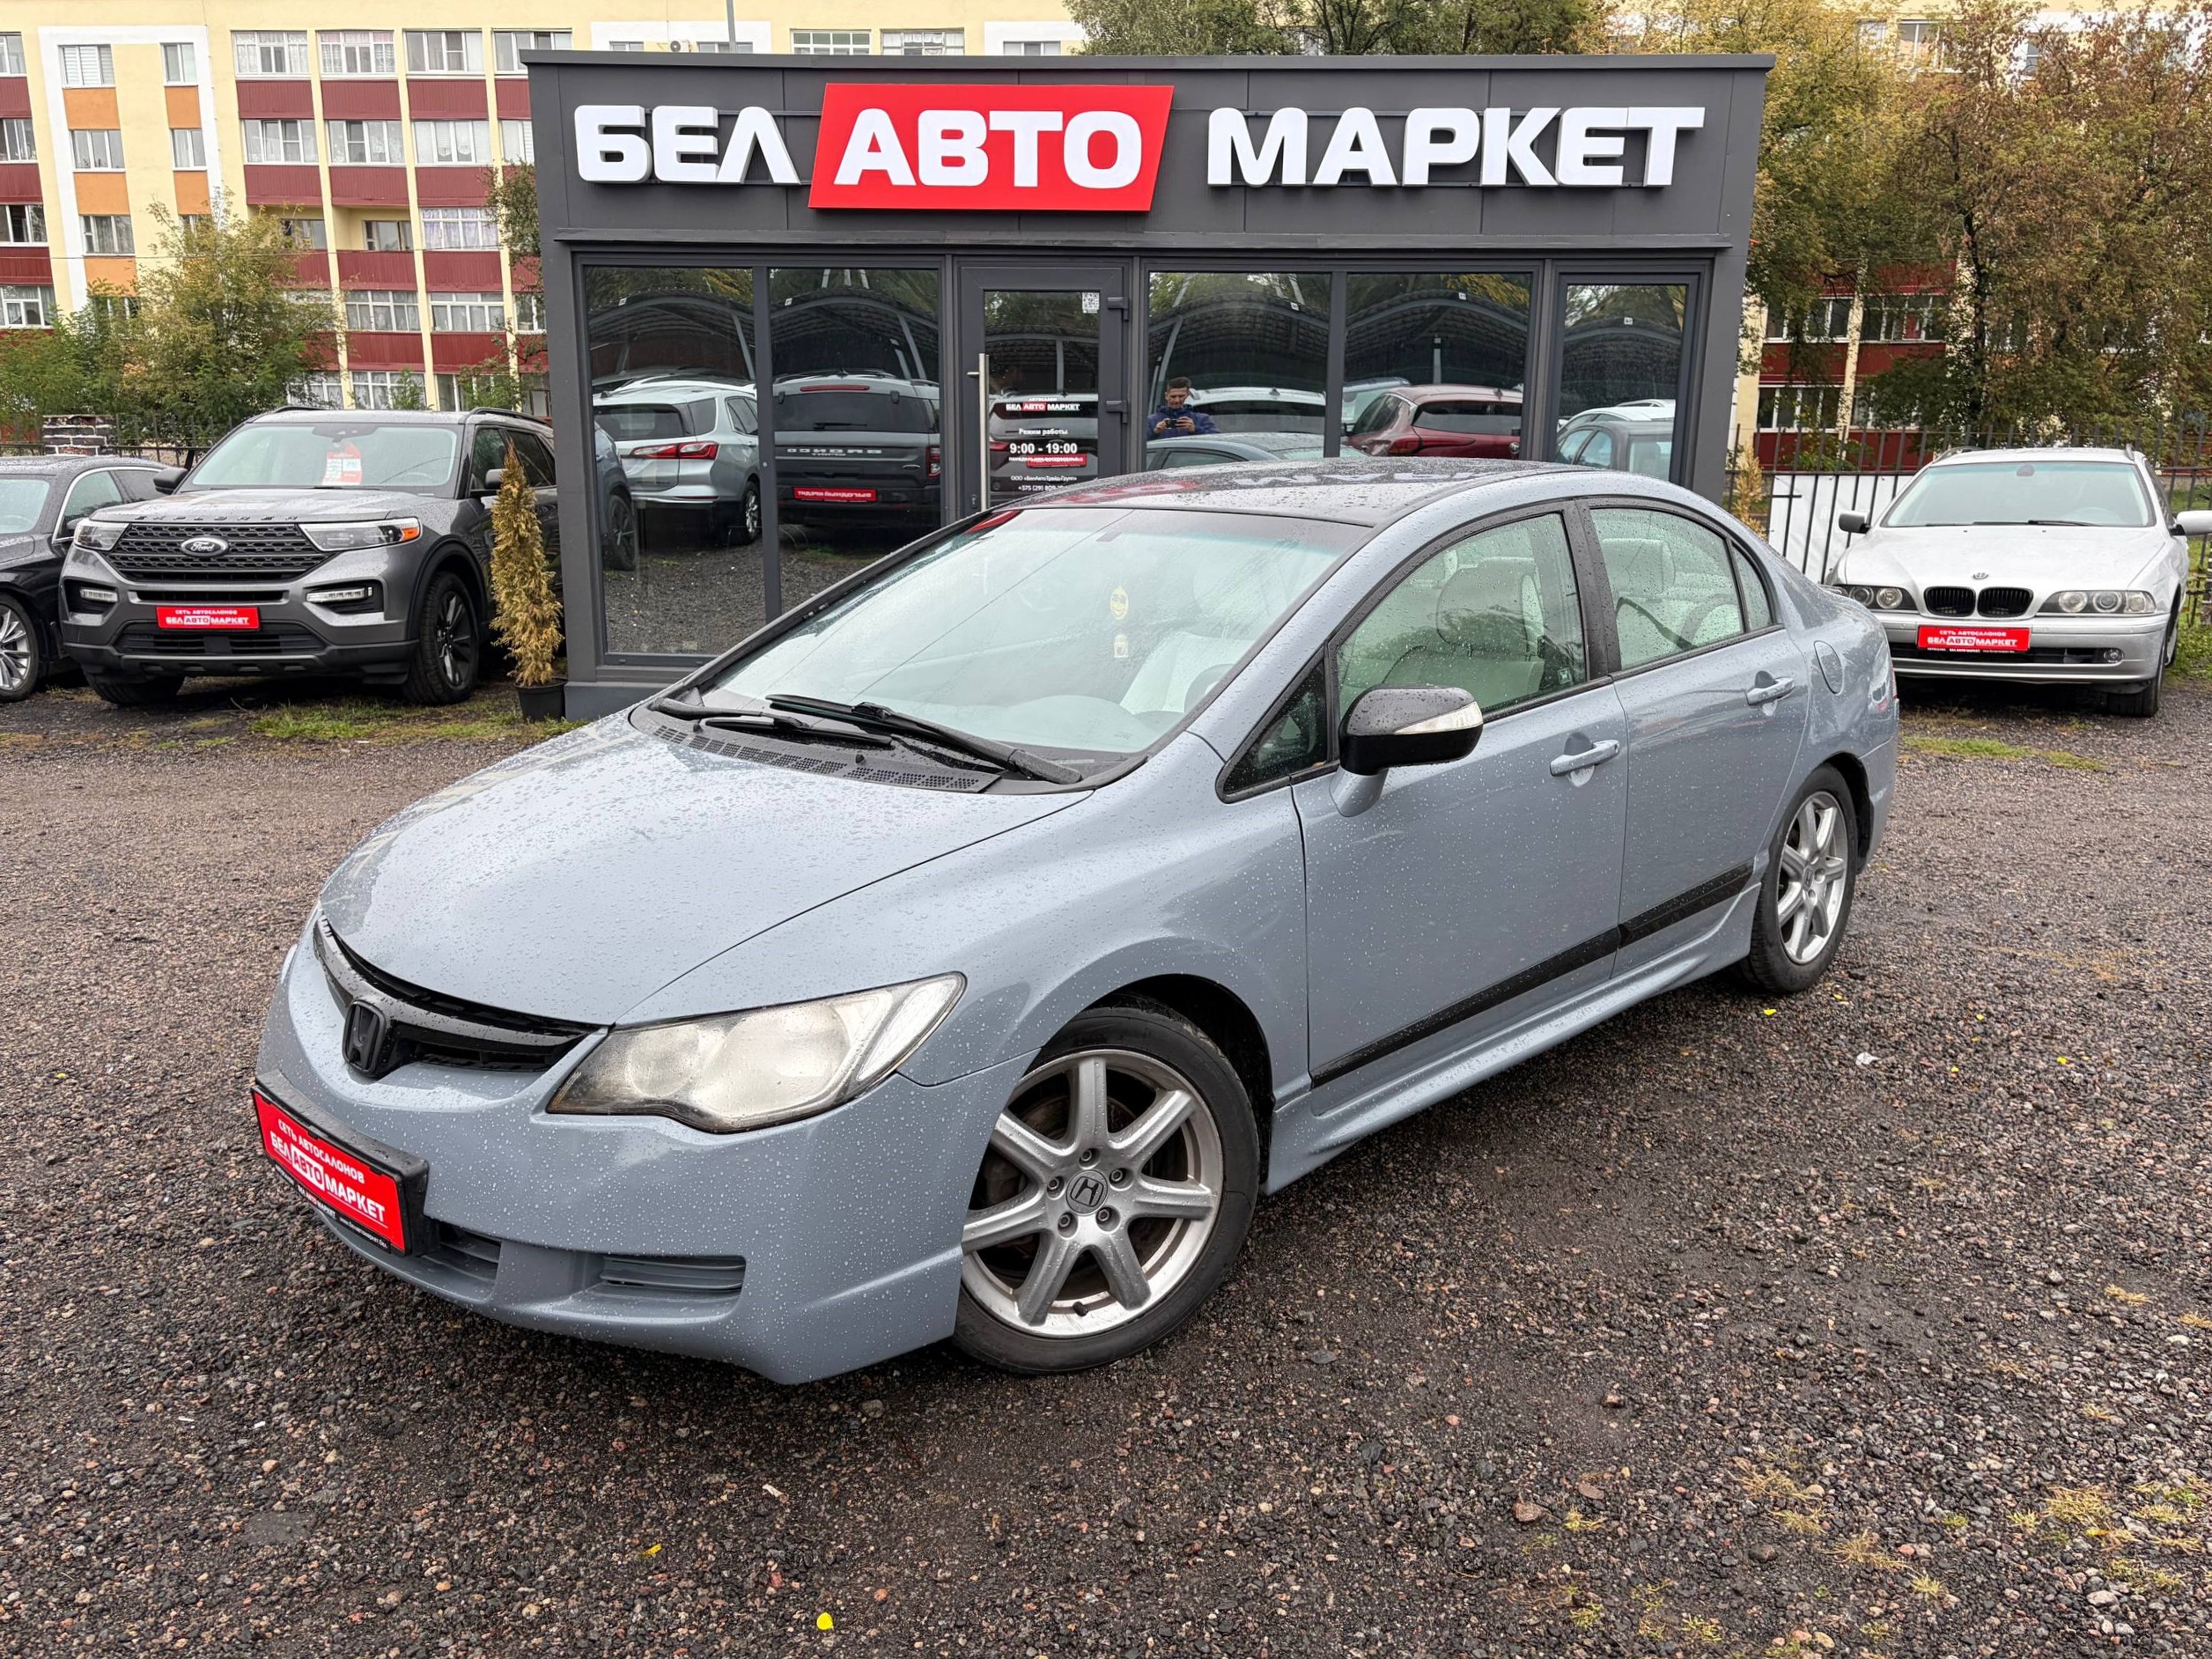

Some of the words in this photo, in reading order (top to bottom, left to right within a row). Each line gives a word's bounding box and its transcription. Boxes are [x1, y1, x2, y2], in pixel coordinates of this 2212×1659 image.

[574, 105, 801, 185] БЕЛ
[834, 107, 1143, 188] АВТО
[1207, 106, 1706, 188] МАРКЕТ
[1009, 443, 1035, 453] 9:00
[1045, 443, 1077, 453] 19:00
[190, 542, 215, 552] Ford
[269, 1131, 292, 1161] БЕЛ
[292, 1150, 323, 1184] АВТО
[325, 1173, 386, 1223] МАРКЕТ
[277, 1118, 298, 1142] СЕТЬ
[299, 1138, 365, 1184] АВТОСАЛОНОВ
